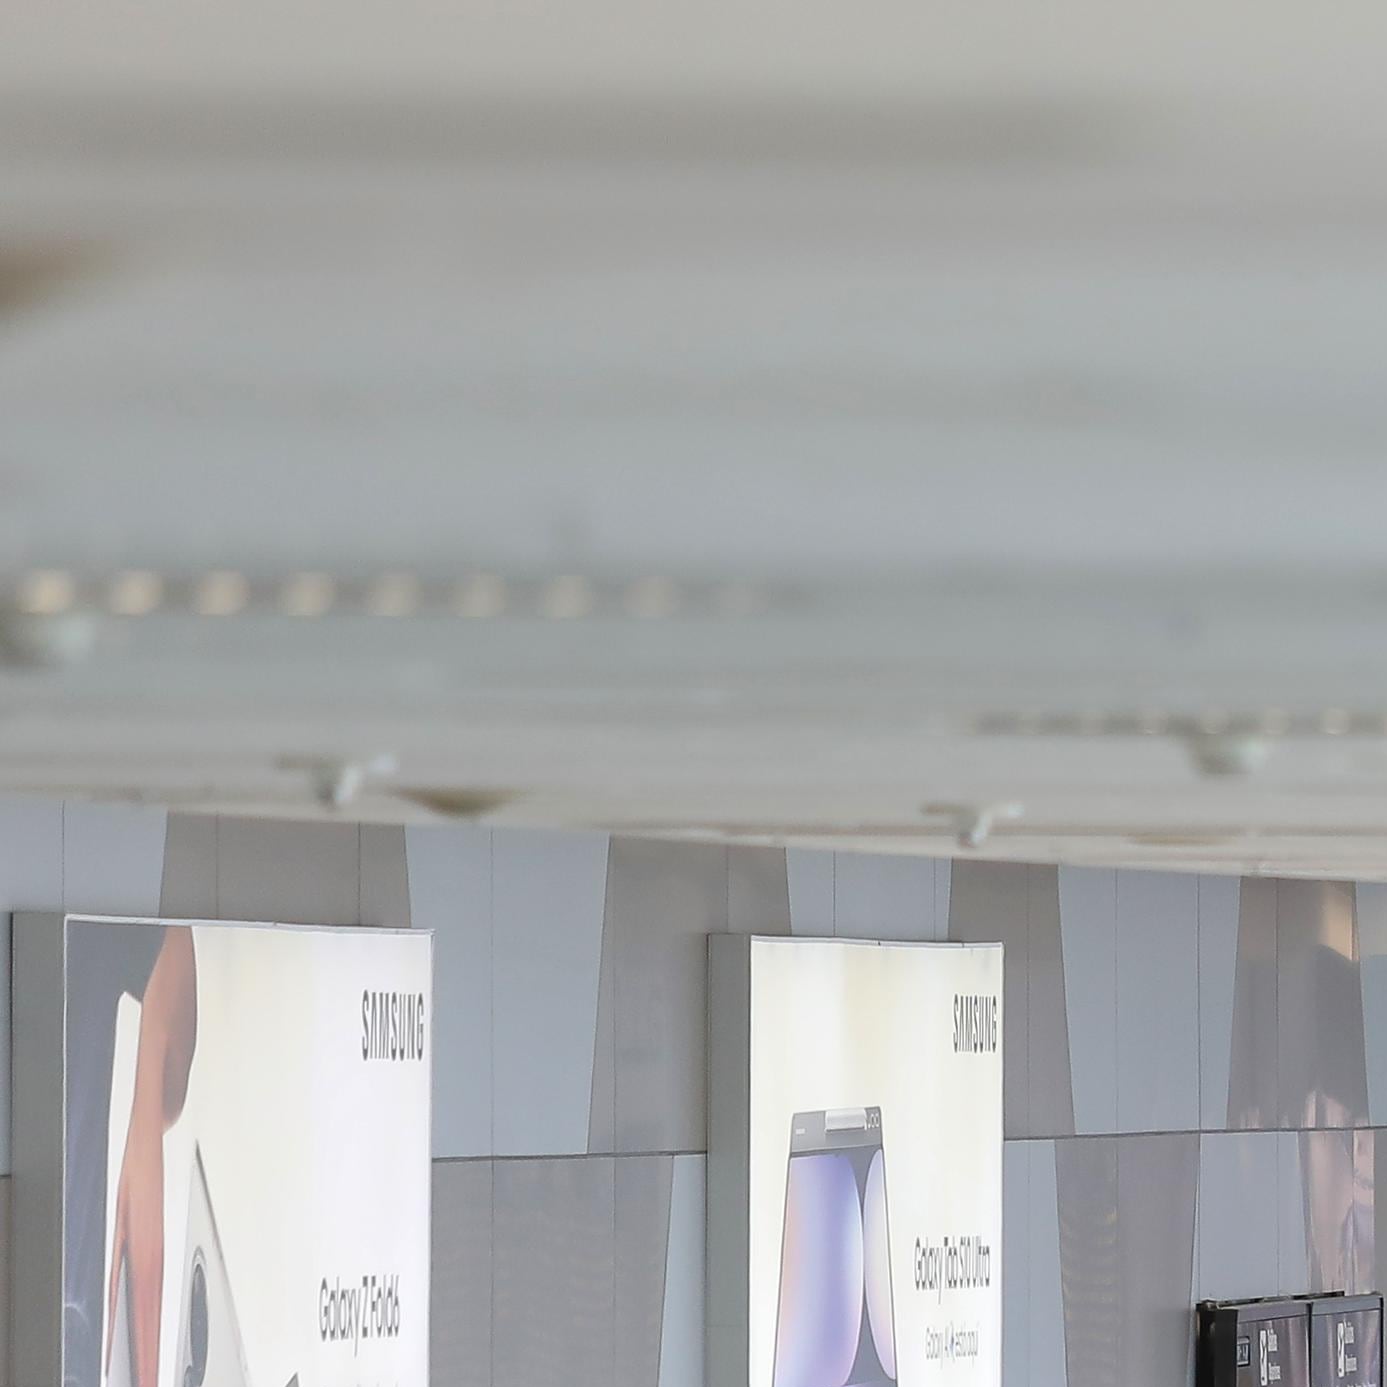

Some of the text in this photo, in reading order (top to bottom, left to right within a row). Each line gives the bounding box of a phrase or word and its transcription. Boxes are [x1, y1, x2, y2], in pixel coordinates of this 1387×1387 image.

[361, 990, 425, 1061] SAMSUNG
[953, 994, 998, 1054] SAMSUNG
[914, 1236, 943, 1305] Galaxy
[319, 1274, 400, 1358] Galaxy Z Fold6
